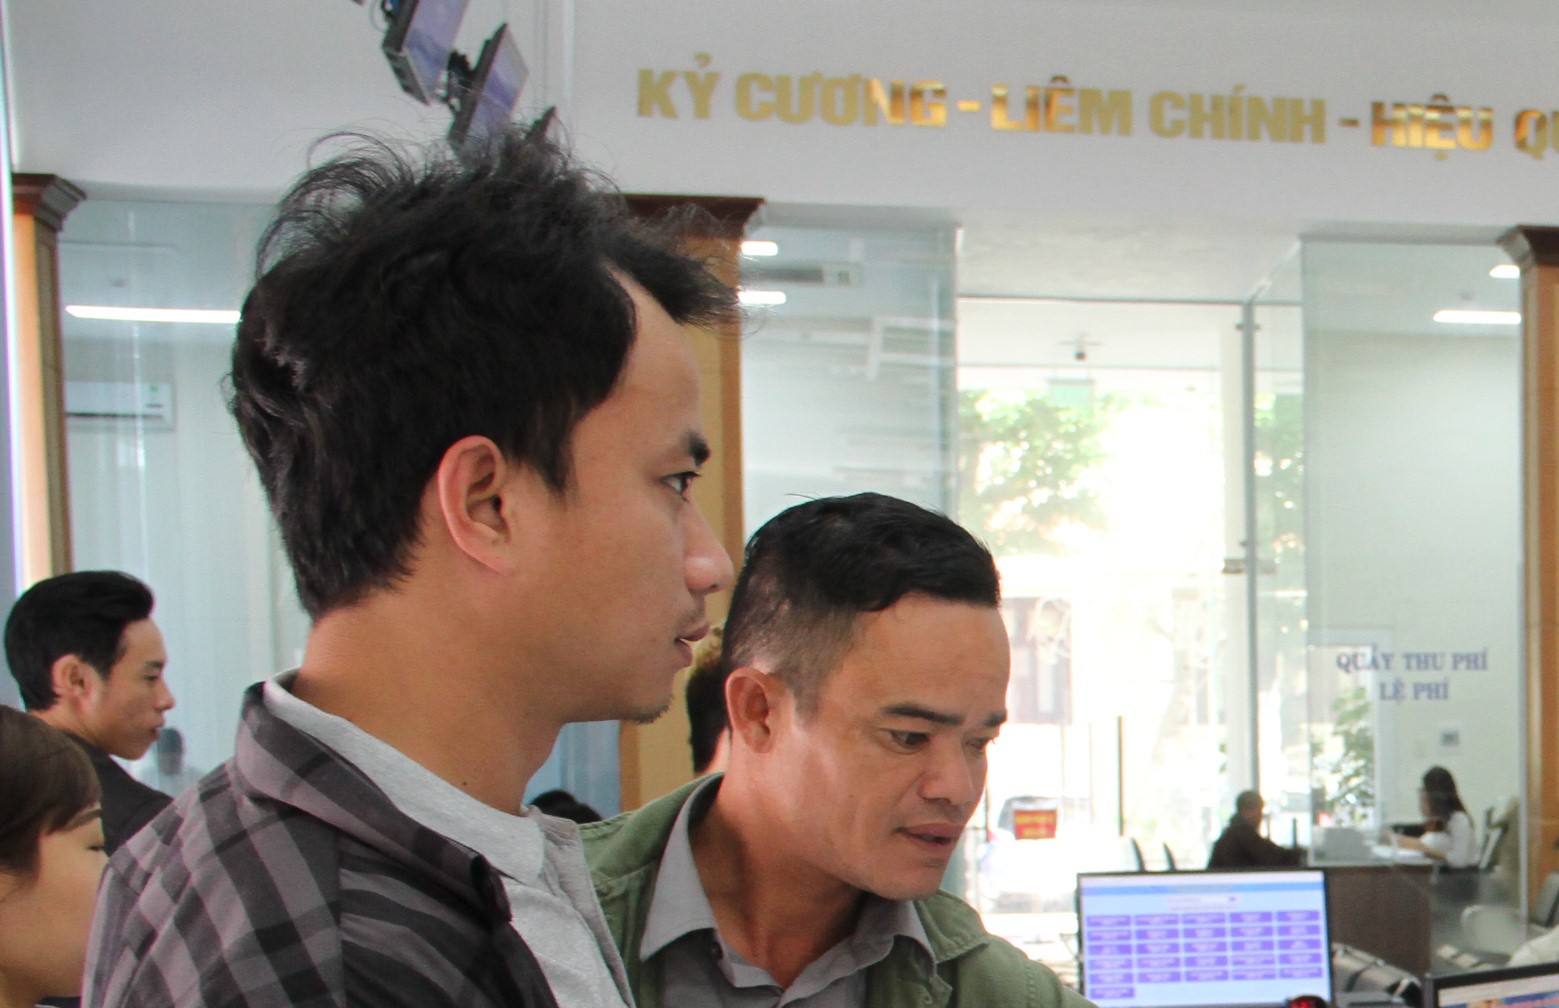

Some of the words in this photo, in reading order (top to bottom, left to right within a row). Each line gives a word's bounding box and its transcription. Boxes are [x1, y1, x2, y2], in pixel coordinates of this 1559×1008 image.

[636, 52, 720, 119] KỶ
[735, 70, 946, 127] CƯƠNG
[990, 75, 1133, 136] LIÊM
[1148, 84, 1326, 143] CHÍNH
[1370, 94, 1494, 161] HIỆU
[1403, 652, 1445, 671] THU
[1452, 647, 1488, 671] PHÍ
[1413, 677, 1448, 700] PHÍ
